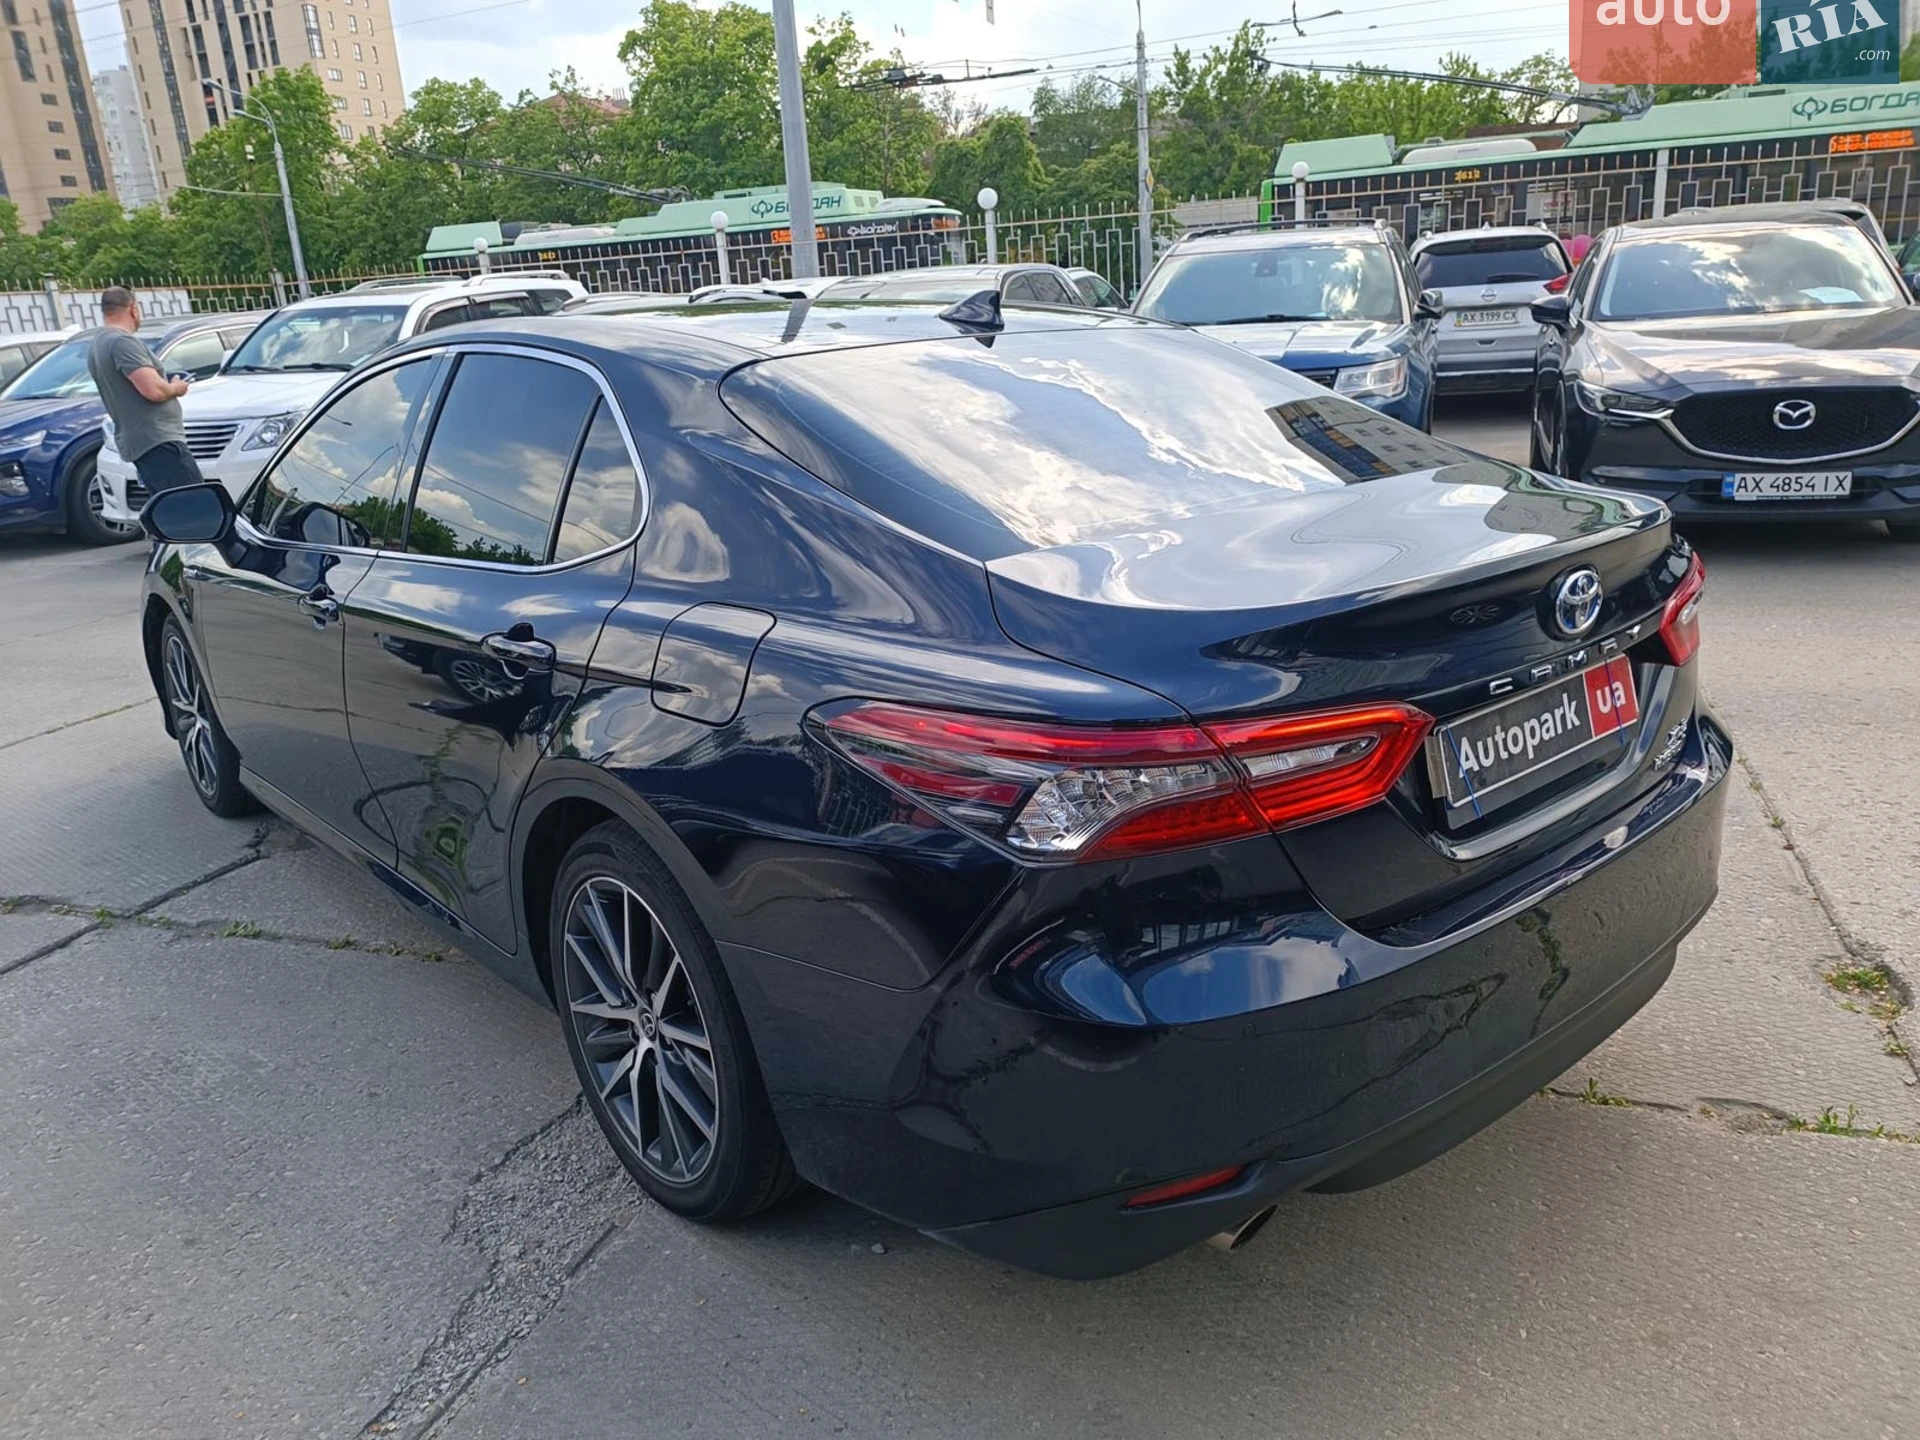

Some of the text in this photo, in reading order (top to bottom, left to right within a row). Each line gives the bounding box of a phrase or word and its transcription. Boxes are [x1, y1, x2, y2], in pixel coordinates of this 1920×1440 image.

[774, 195, 842, 214] БДАН
[1463, 312, 1476, 323] AX
[1479, 311, 1501, 322] 3199
[1735, 477, 1764, 493] AX
[1769, 476, 1815, 493] 4854
[1824, 475, 1848, 492] IX
[1489, 624, 1642, 696] CAMRY
[1459, 692, 1581, 779] Autopark
[1595, 680, 1627, 714] ua
